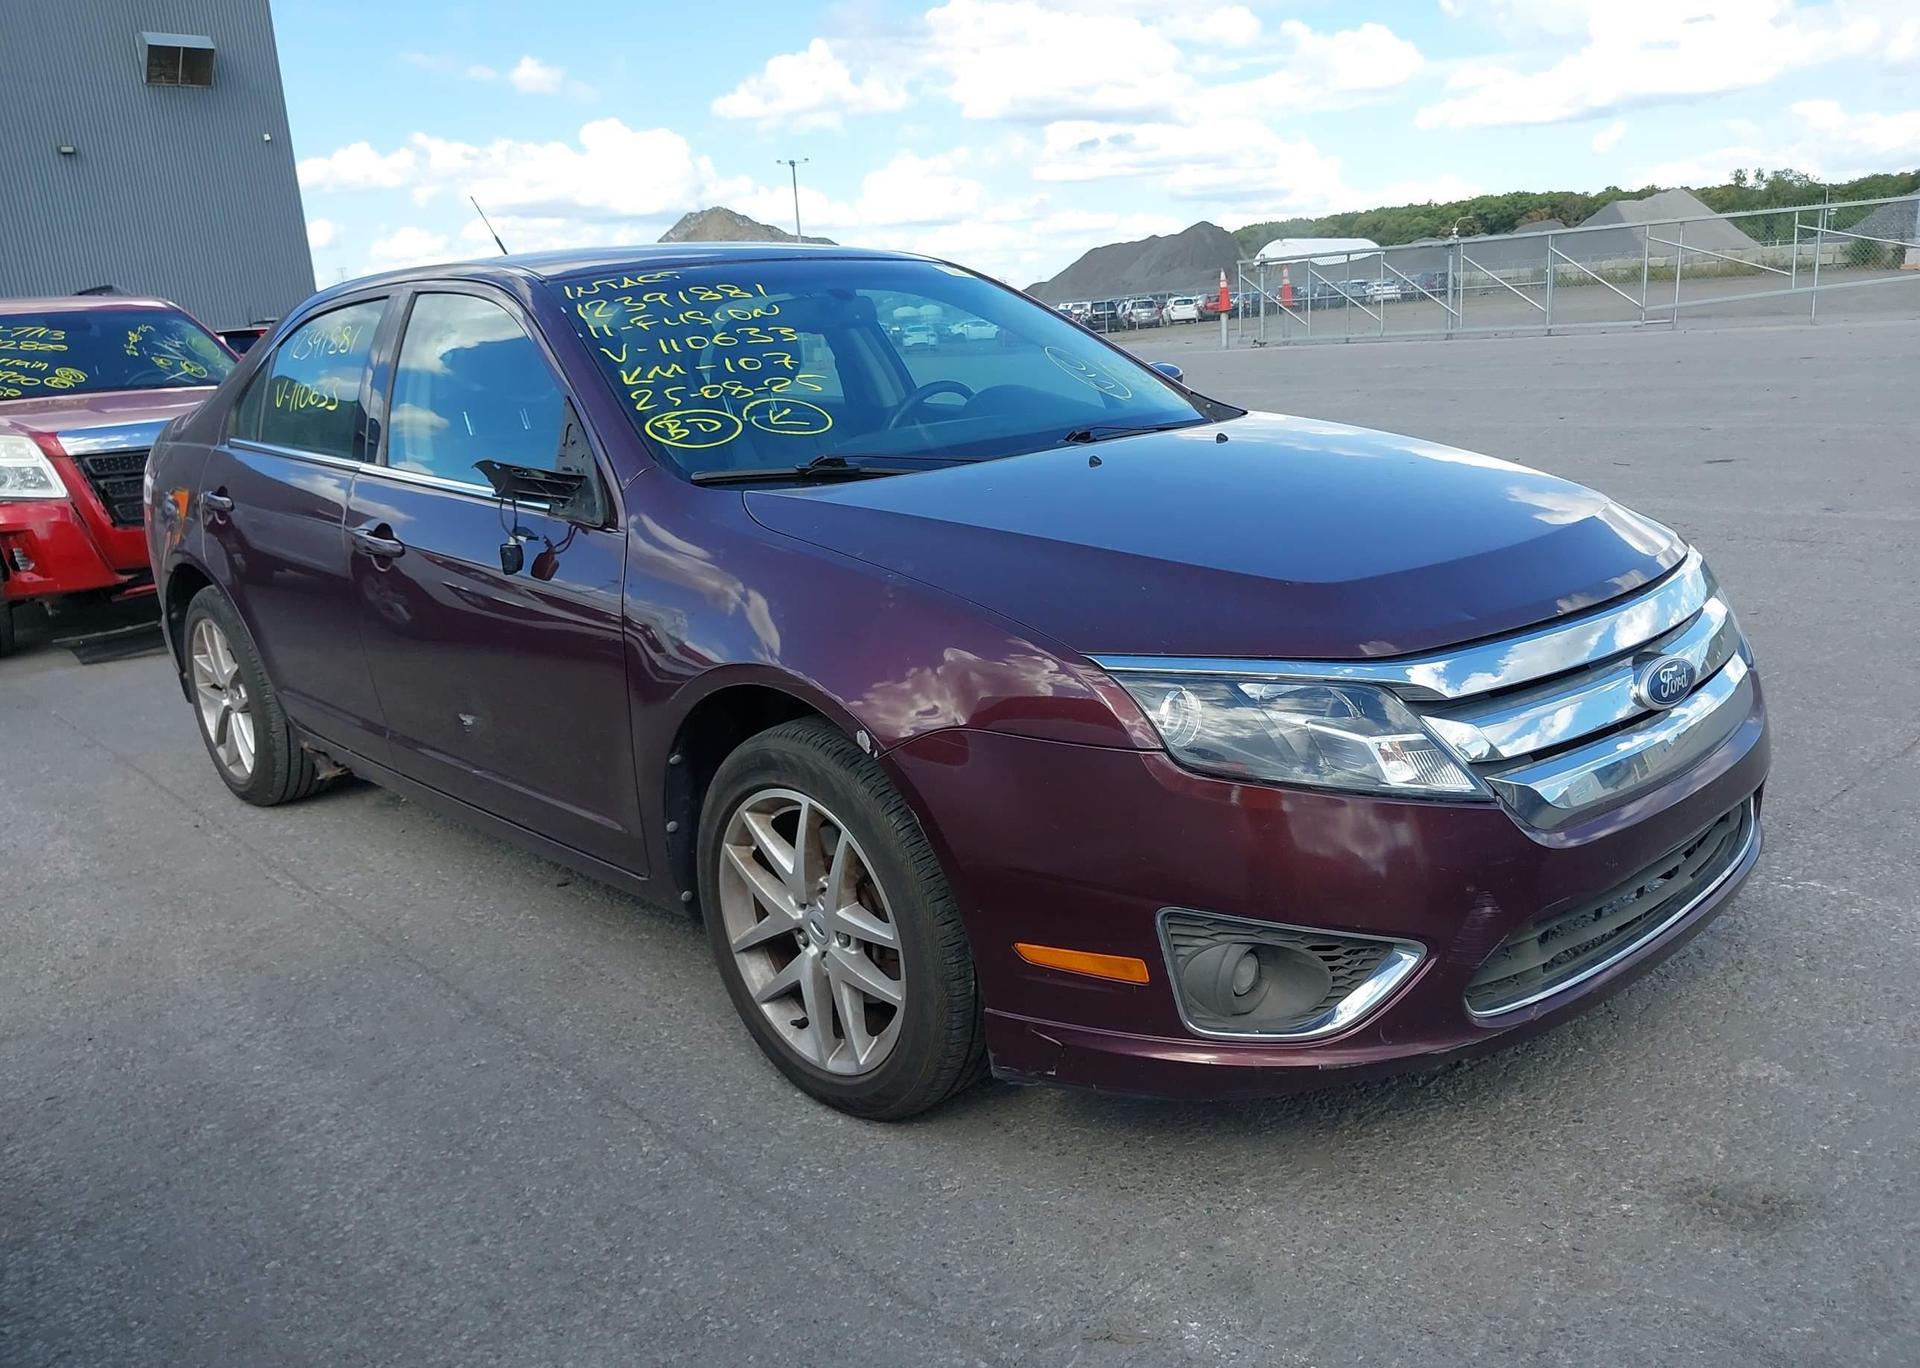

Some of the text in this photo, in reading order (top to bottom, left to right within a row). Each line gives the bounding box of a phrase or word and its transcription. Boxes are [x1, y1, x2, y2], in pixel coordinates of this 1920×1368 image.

[577, 283, 769, 320] 12391881
[600, 326, 799, 363] V-110633
[1660, 665, 1689, 698] Ford
